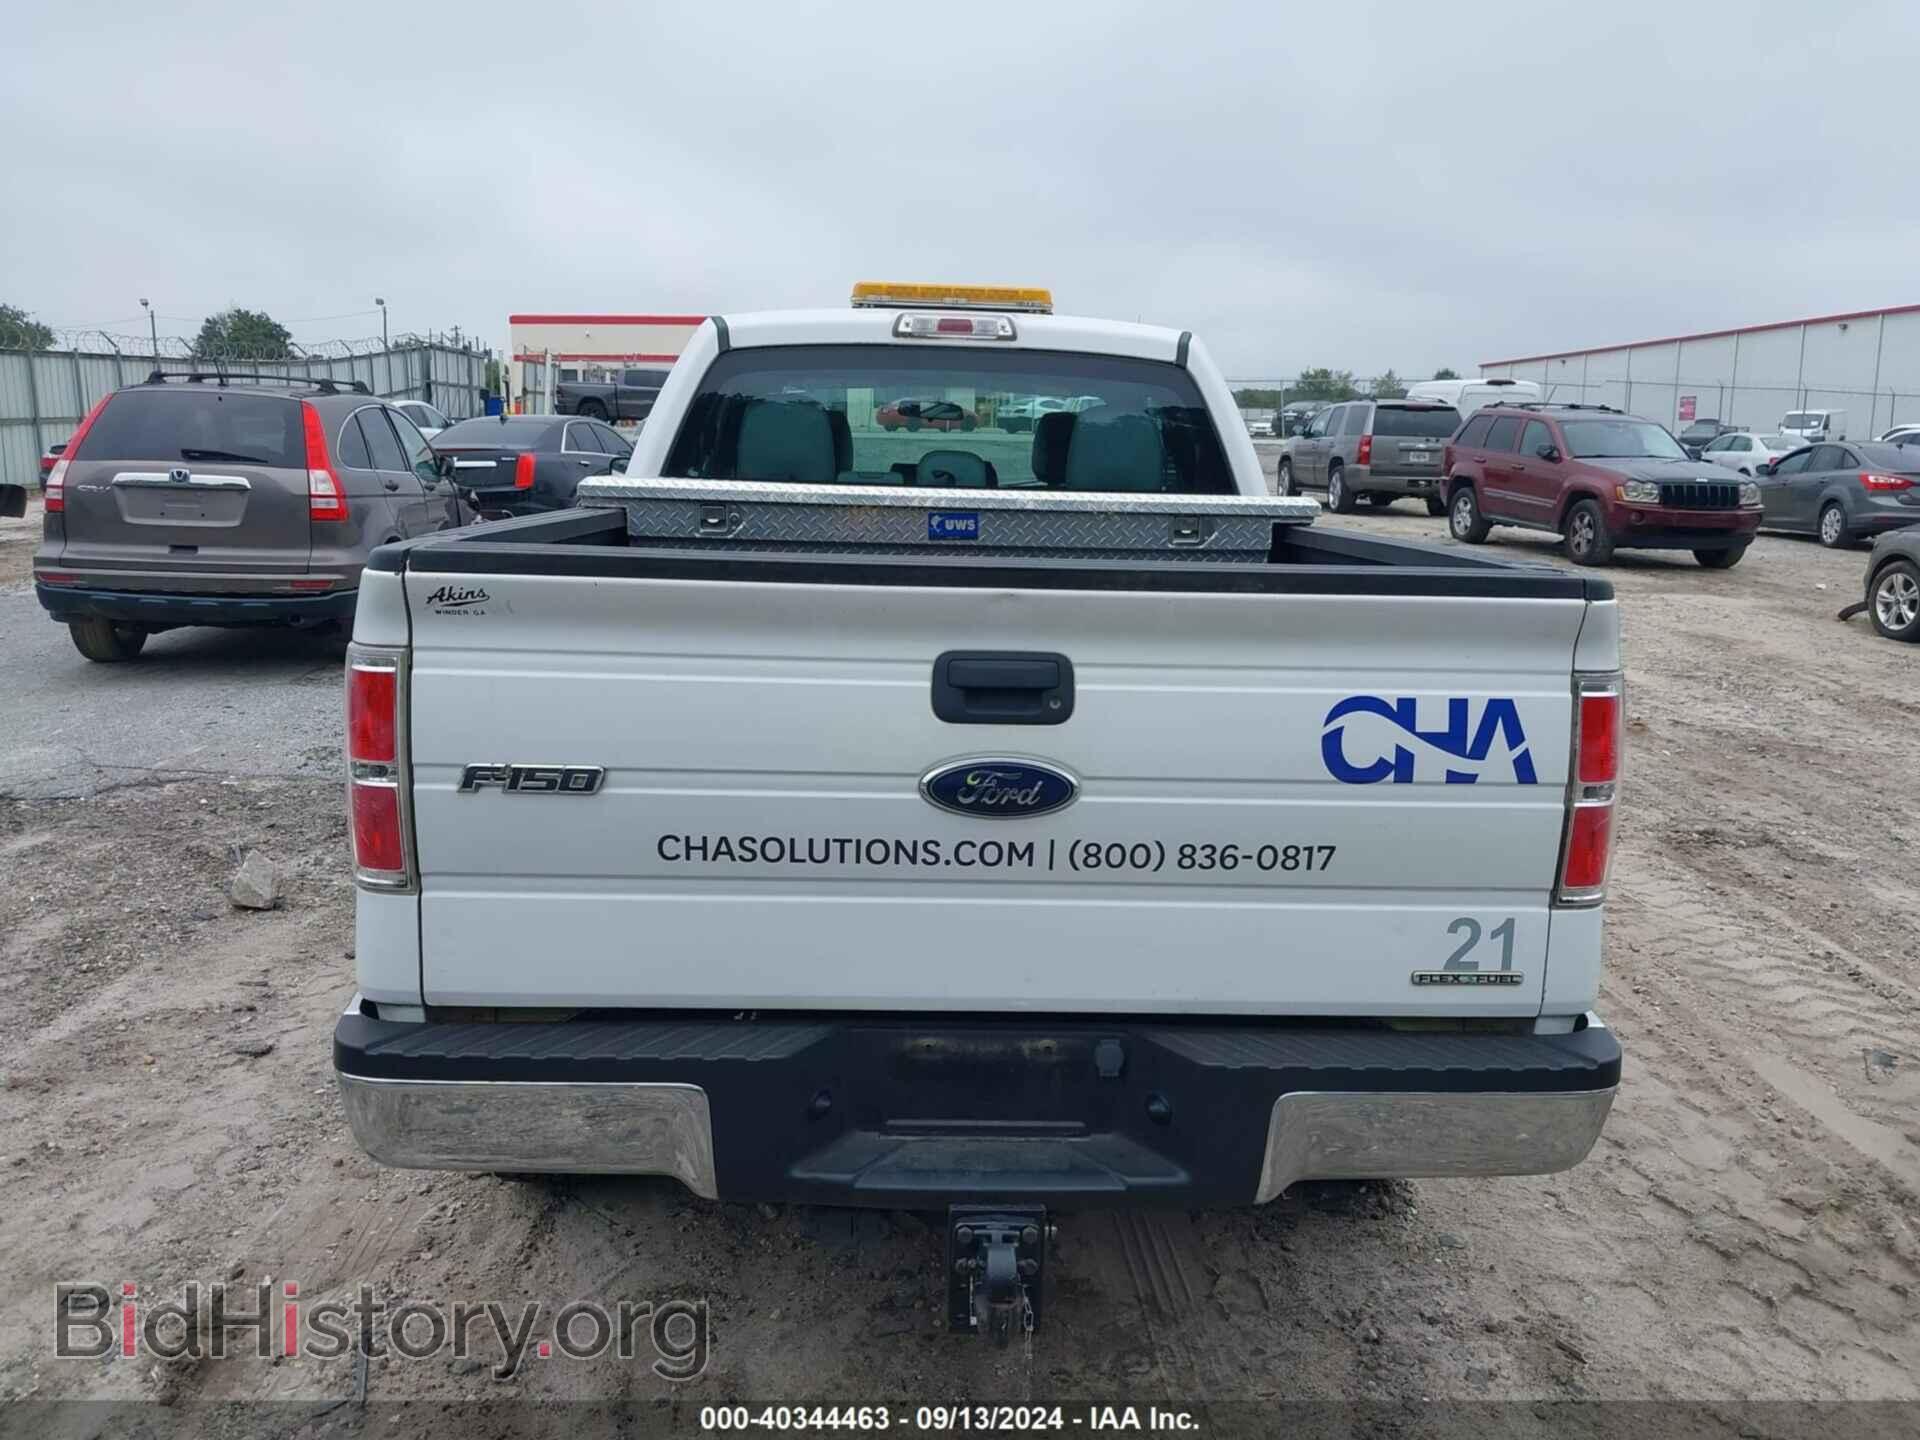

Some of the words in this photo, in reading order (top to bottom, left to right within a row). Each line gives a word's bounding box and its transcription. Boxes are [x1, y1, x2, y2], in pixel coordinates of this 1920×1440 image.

[944, 519, 976, 530] UWS
[425, 586, 490, 606] Akins
[1321, 695, 1538, 784] CHA
[457, 763, 605, 795] F-150
[957, 769, 1044, 805] Ford
[656, 834, 1035, 868] CHASOLUTIONS.COM
[1068, 839, 1166, 872] (800)
[1176, 843, 1337, 871] 836-0817
[1443, 917, 1516, 971] 21
[1418, 973, 1462, 986] FLEX
[1477, 973, 1522, 986] FUEL
